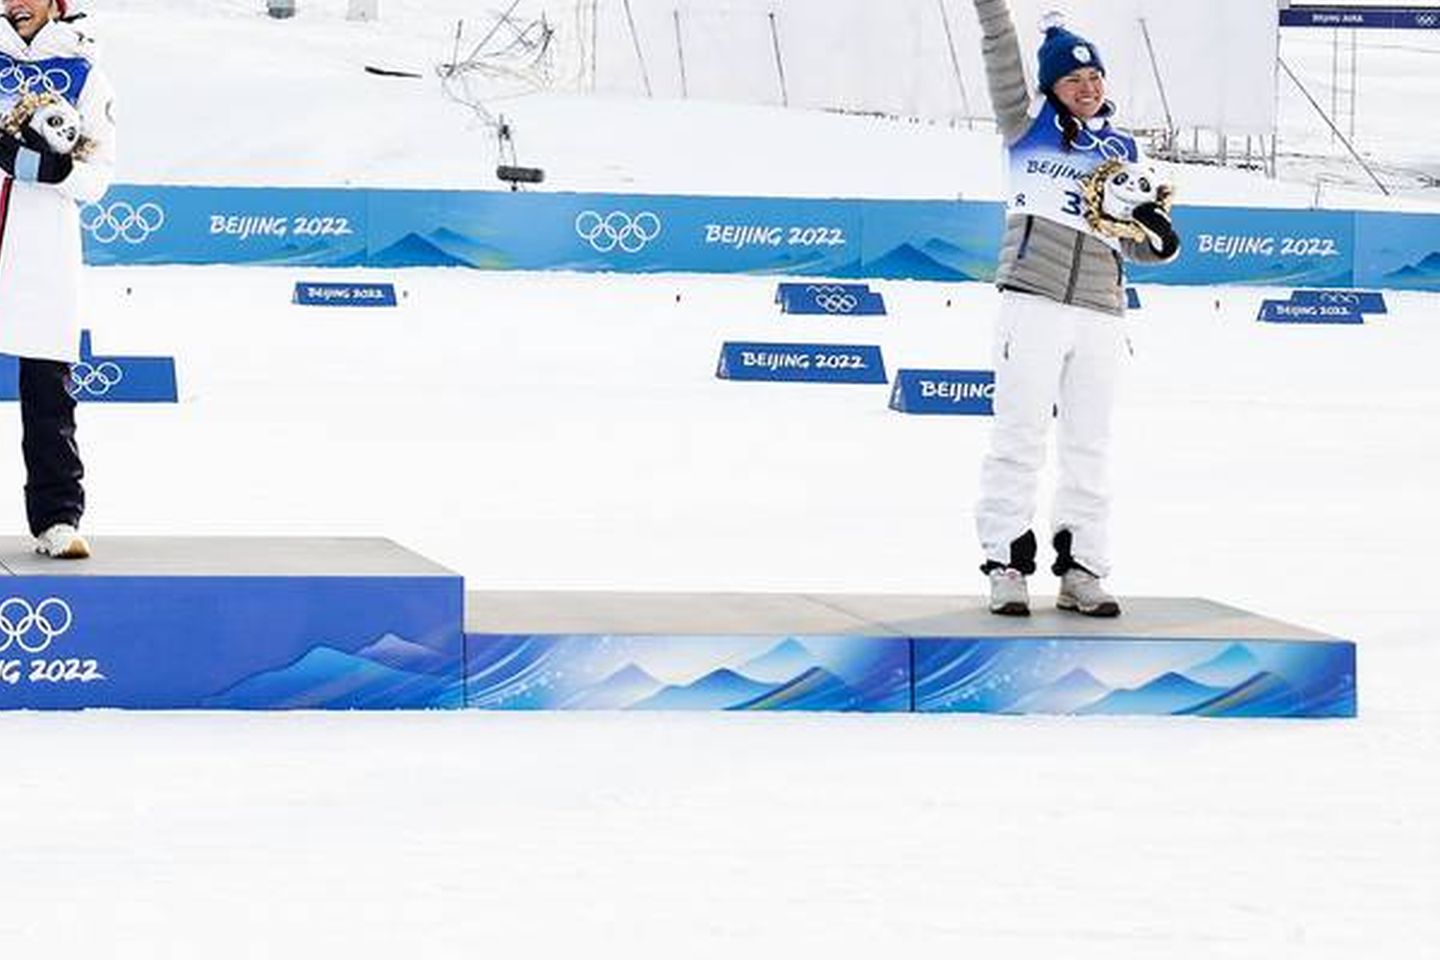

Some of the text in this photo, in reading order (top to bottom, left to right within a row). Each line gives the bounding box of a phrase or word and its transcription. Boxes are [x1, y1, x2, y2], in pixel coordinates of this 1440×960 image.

[210, 215, 354, 240] BEIJING 2022
[704, 225, 846, 250] BEIJING 2022
[1198, 234, 1340, 258] BEIJING 2022
[741, 352, 869, 371] BEIJING 2022
[920, 381, 996, 403] BEIJING
[28, 659, 108, 682] 2022
